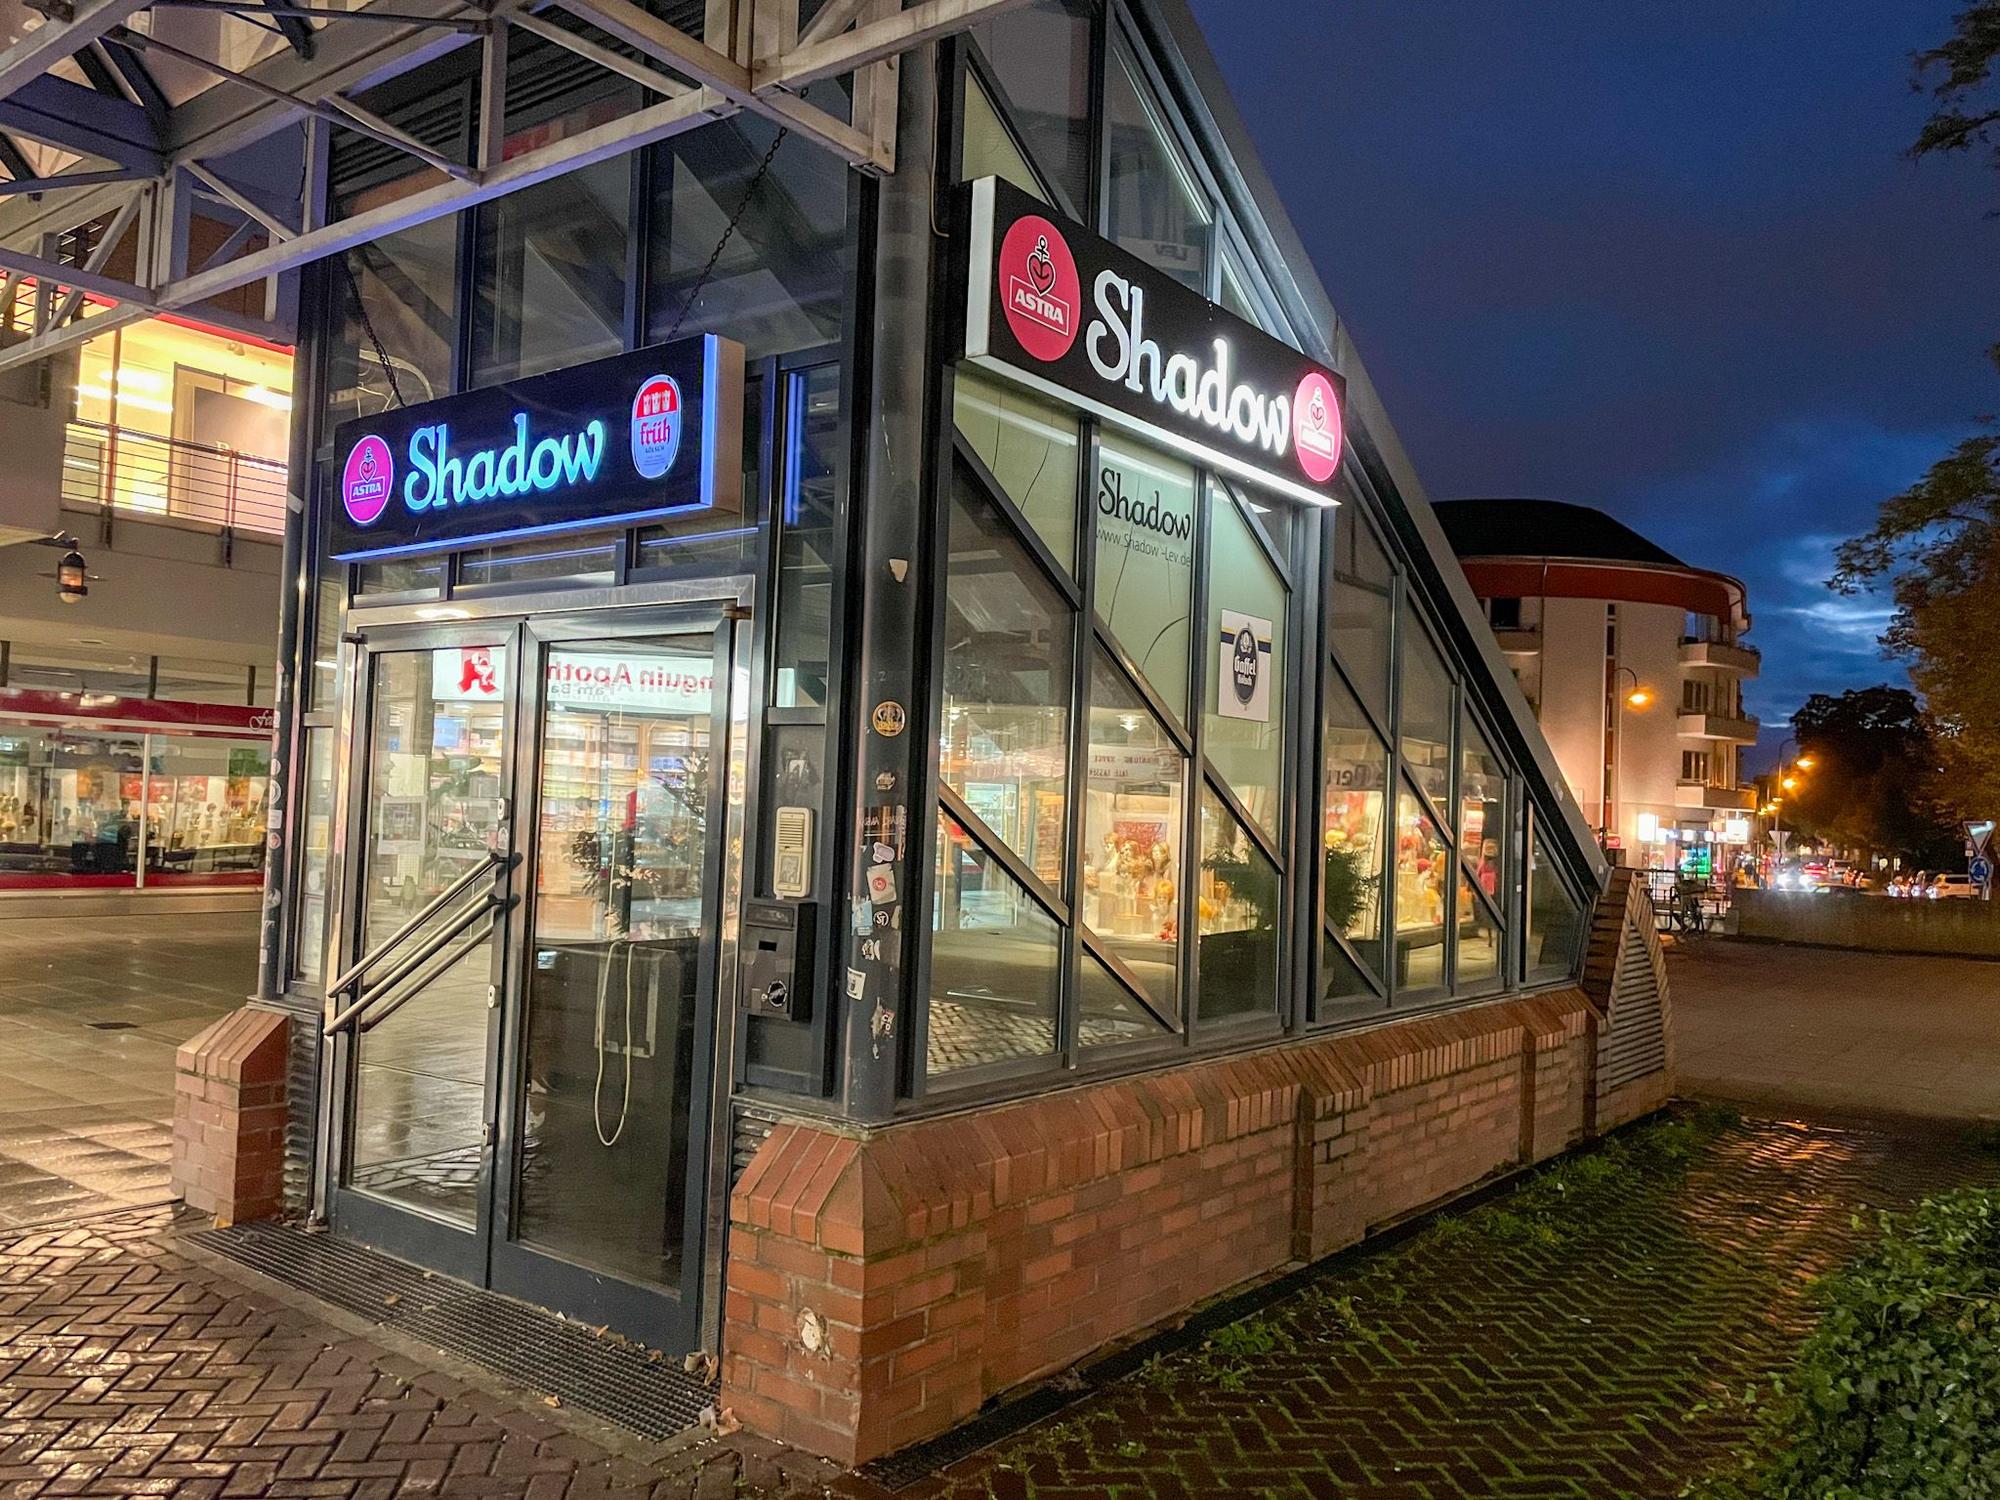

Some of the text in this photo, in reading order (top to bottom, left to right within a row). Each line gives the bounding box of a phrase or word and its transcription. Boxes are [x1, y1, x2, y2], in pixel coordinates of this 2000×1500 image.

[1015, 289, 1063, 324] ASTRA
[1086, 269, 1290, 456] Shadow
[639, 420, 671, 446] früh
[403, 413, 606, 513] Shadow
[352, 484, 382, 498] ASTRA
[1098, 467, 1191, 541] Shadow
